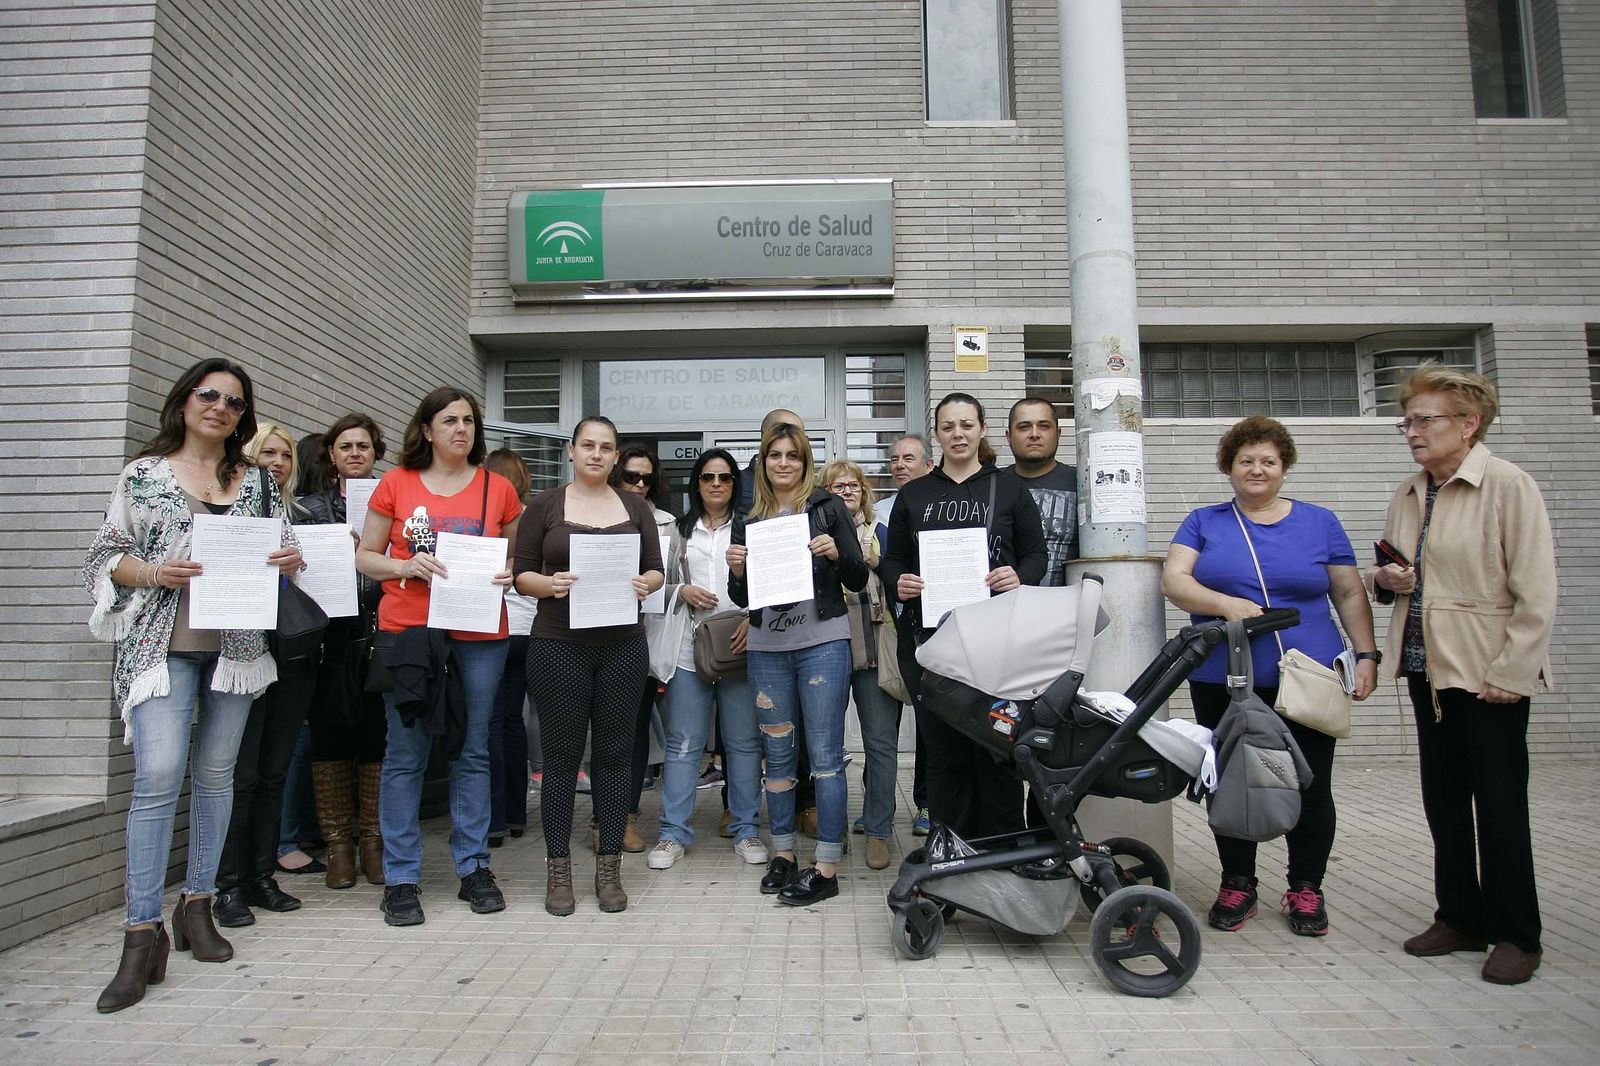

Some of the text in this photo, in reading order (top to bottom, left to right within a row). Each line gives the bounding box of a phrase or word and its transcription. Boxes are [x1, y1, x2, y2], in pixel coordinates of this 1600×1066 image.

[717, 214, 873, 238] Centro de Salud
[763, 241, 873, 257] Cruz de Caravaca
[535, 257, 553, 265] JUNTA
[554, 256, 562, 264] DE
[608, 367, 798, 385] CENTRO DE SALUD
[604, 393, 801, 411] CRUZ DE CARAVACA
[674, 447, 702, 459] CEN
[768, 612, 807, 632] Love
